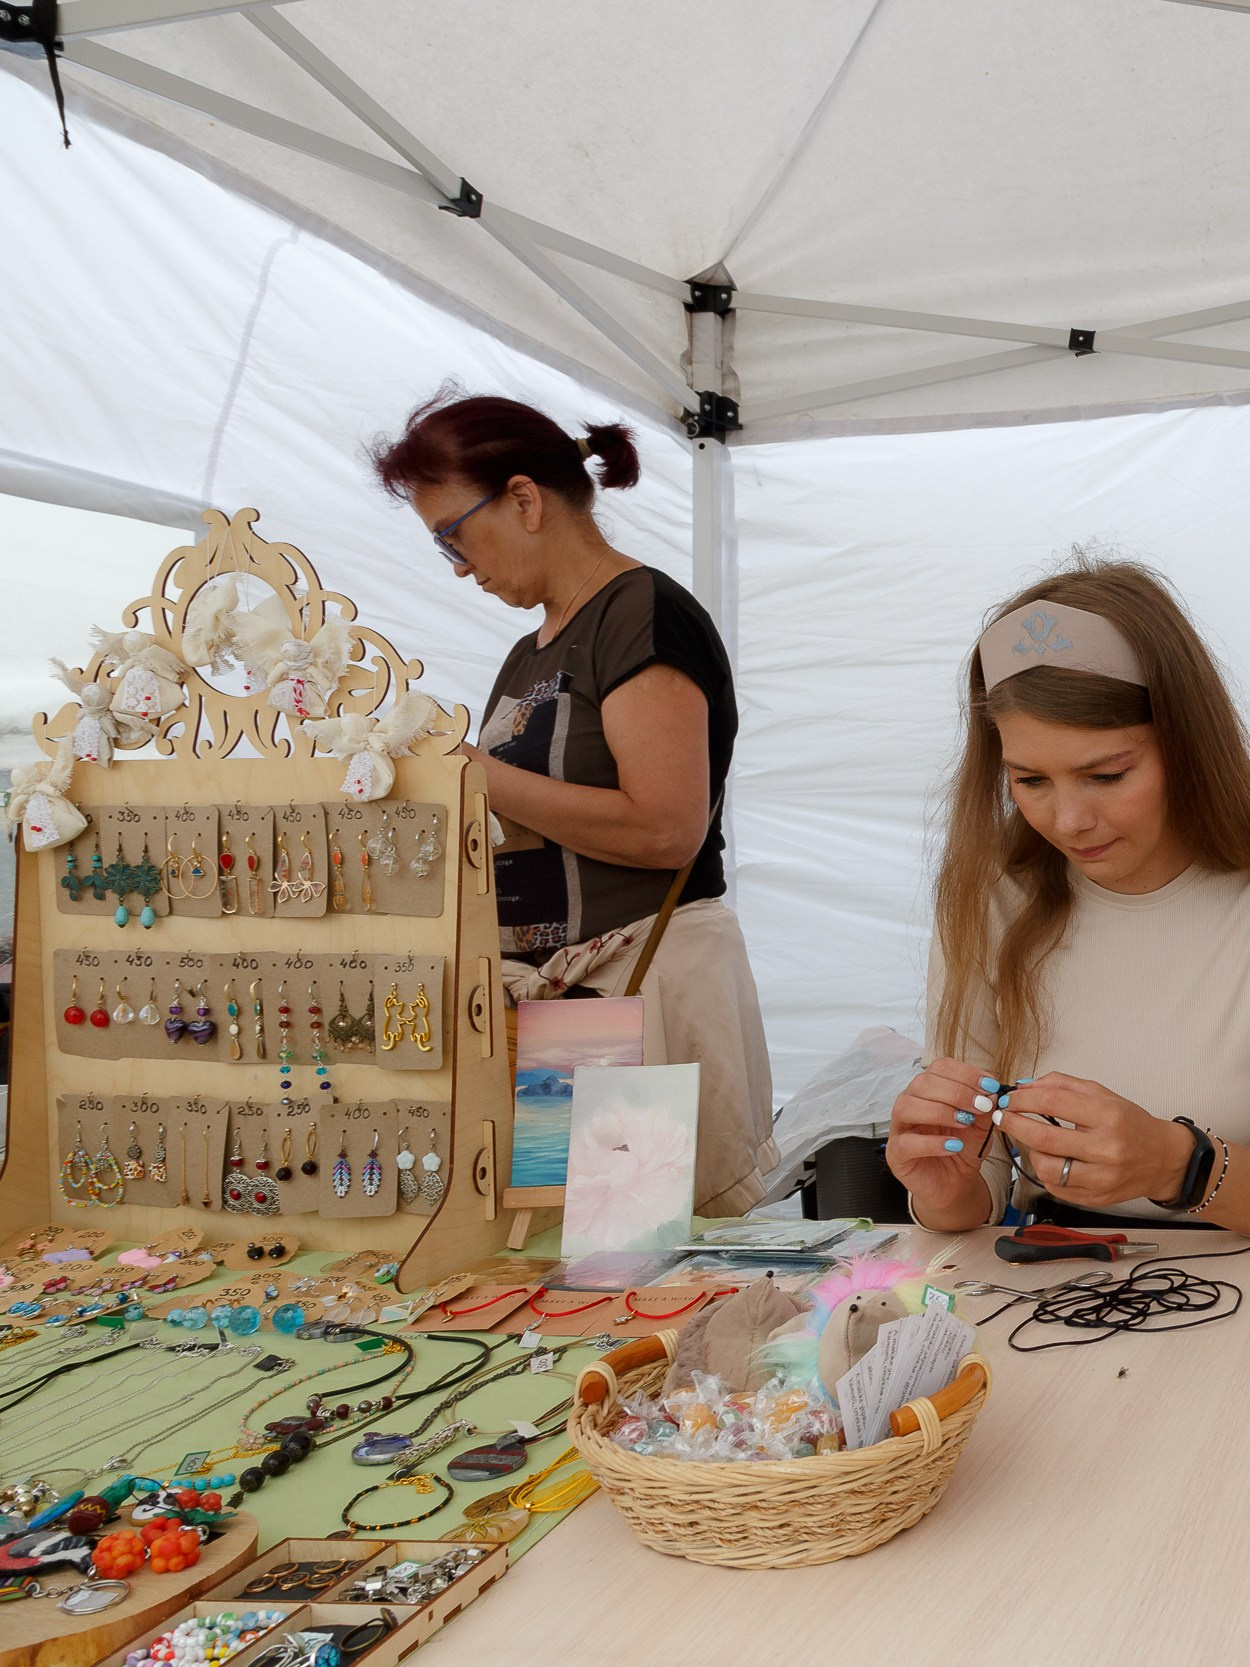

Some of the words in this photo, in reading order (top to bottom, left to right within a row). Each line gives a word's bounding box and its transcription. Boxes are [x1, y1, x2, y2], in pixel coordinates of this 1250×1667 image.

[117, 811, 141, 823] 350
[175, 810, 196, 821] 400
[228, 810, 249, 821] 450
[282, 811, 302, 823] 450
[338, 807, 363, 820] 450
[395, 806, 416, 819] 450
[76, 954, 100, 967] 450
[126, 954, 153, 967] 450
[178, 957, 204, 968] 500
[232, 958, 259, 970] 400
[284, 958, 314, 969] 400
[339, 958, 368, 969] 400
[394, 962, 415, 973] 350
[79, 1099, 104, 1111] 250
[130, 1101, 160, 1114] 300
[238, 1105, 263, 1117] 250
[287, 1103, 311, 1117] 250
[345, 1107, 371, 1120] 400
[408, 1106, 430, 1118] 450
[59, 1263, 92, 1271] 200
[251, 1272, 281, 1280] 200
[219, 1288, 251, 1297] 350
[929, 1291, 948, 1306] 750
